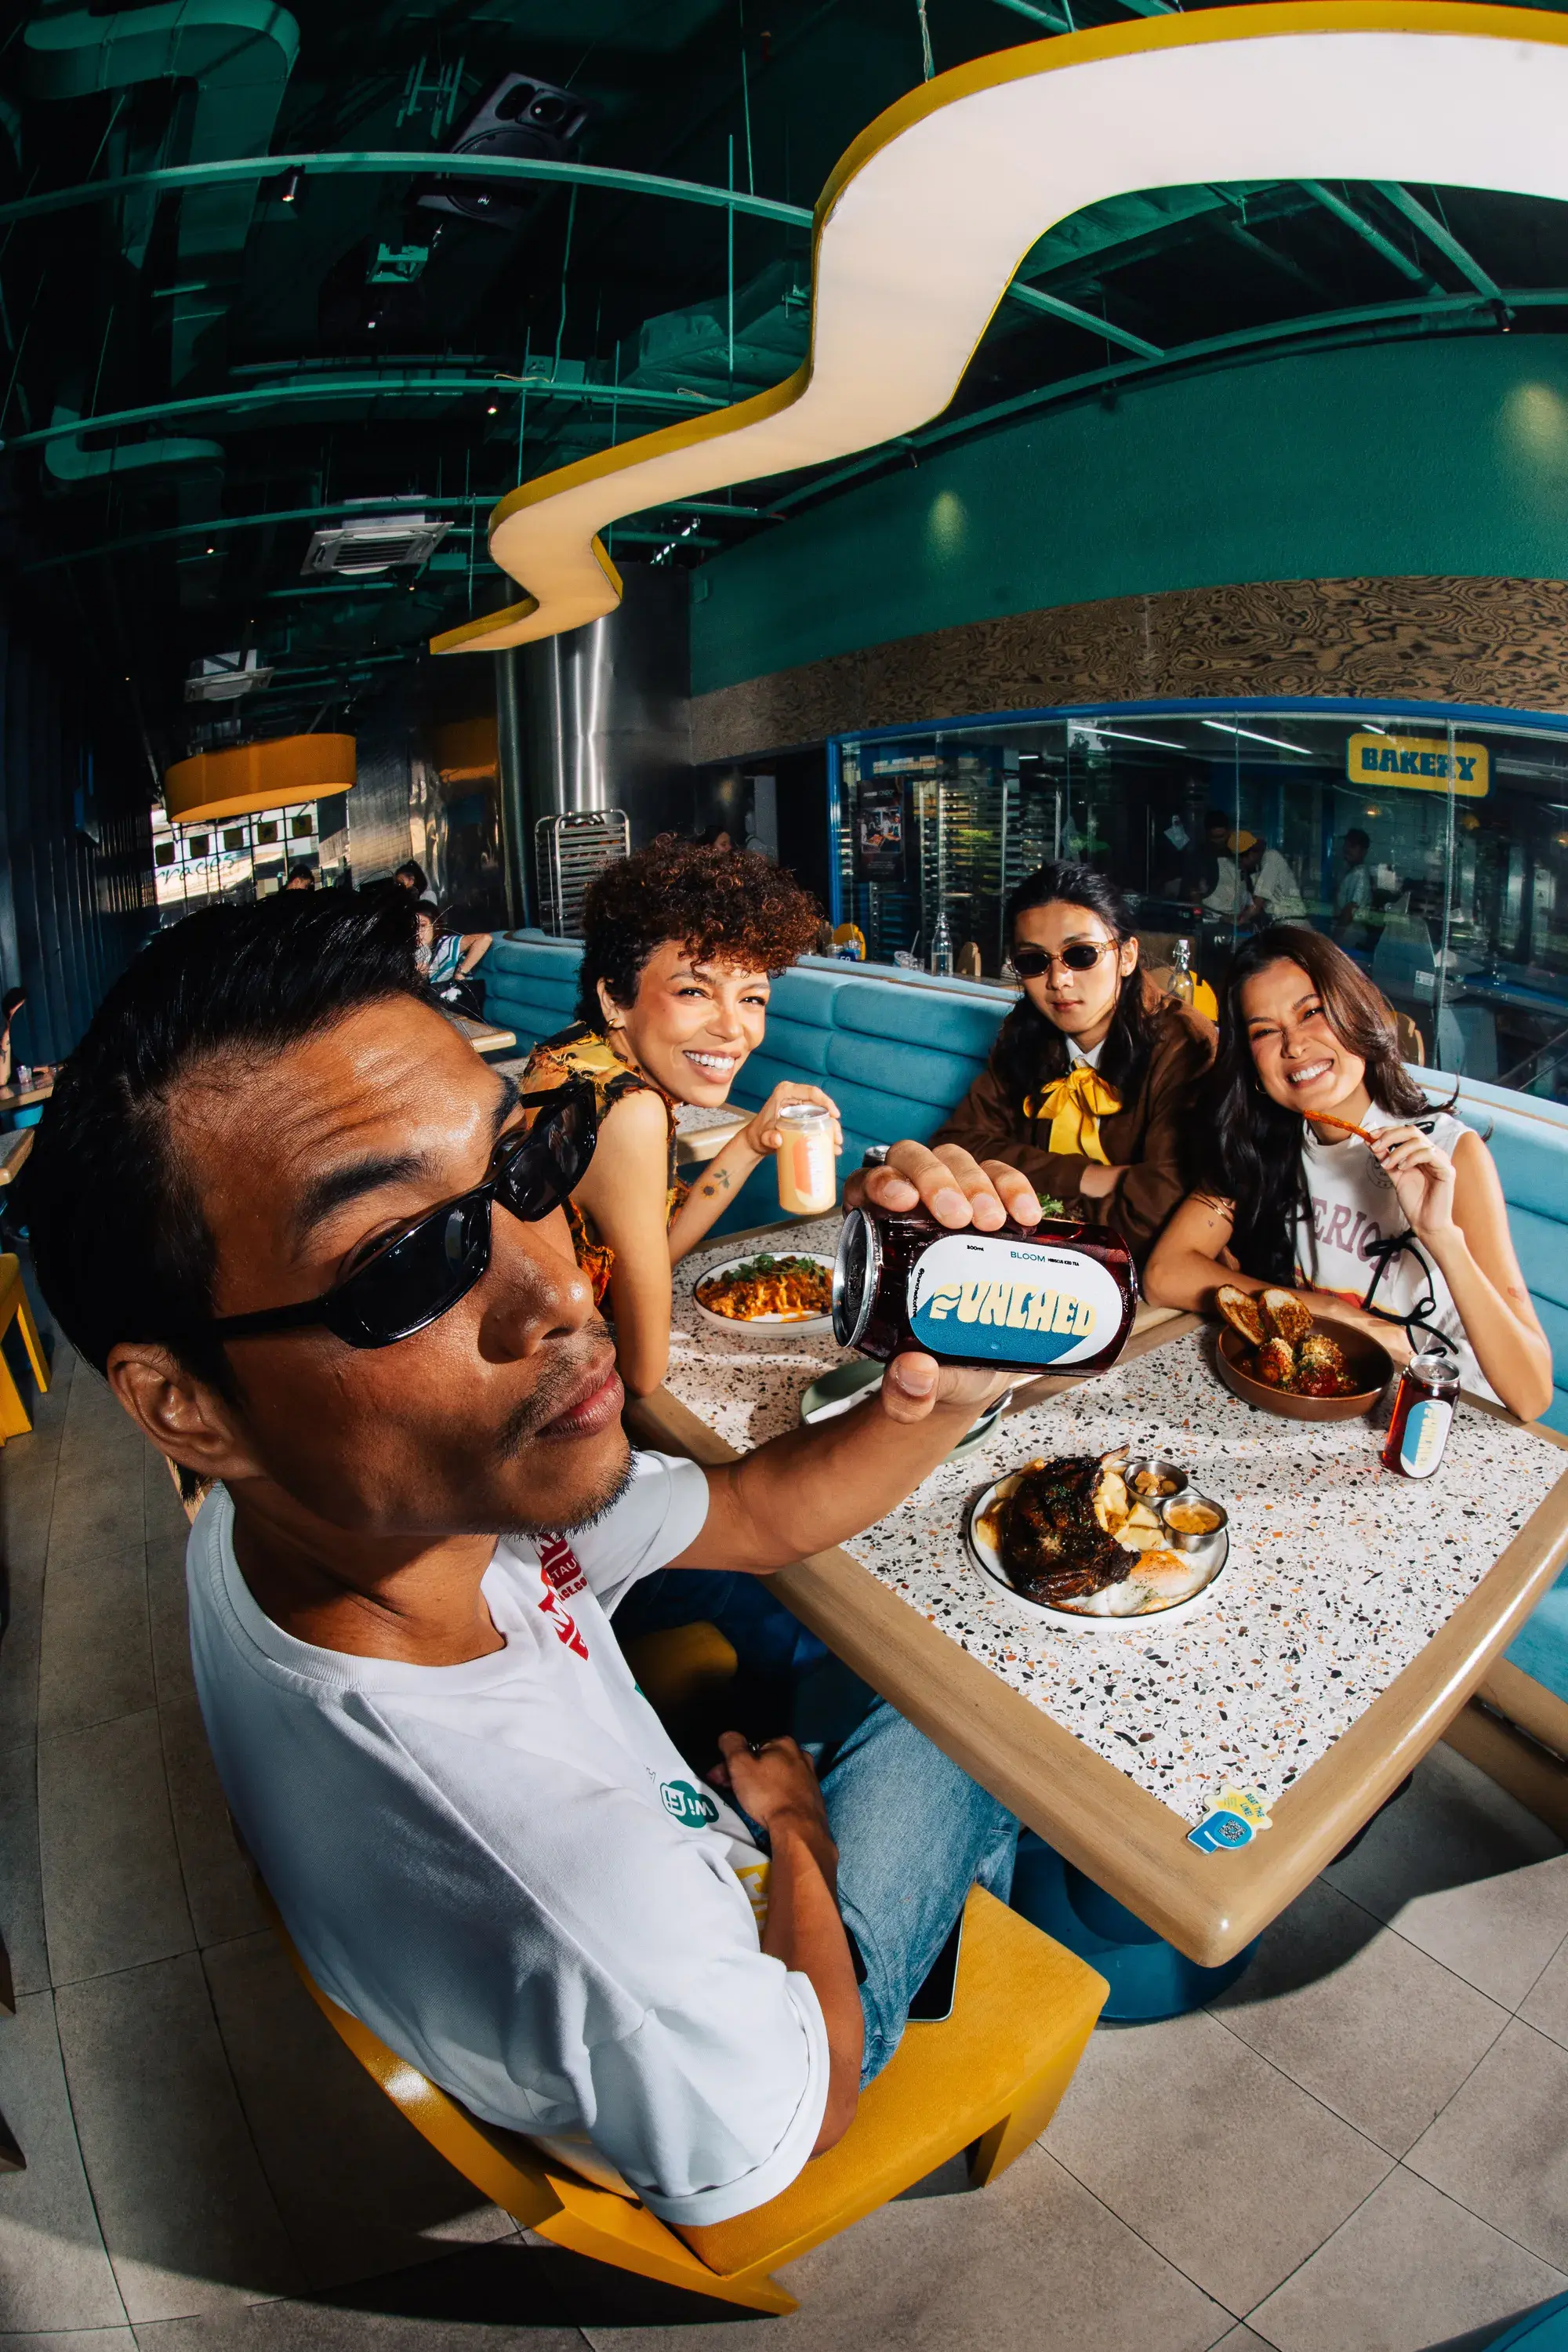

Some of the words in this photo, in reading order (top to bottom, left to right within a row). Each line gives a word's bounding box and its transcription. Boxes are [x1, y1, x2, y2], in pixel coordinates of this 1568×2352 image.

[1361, 747, 1477, 782] BAKERY
[1010, 1250, 1046, 1263] BLOOM
[929, 1280, 1097, 1337] PUNCHED
[559, 1576, 588, 1602] ACE.CO
